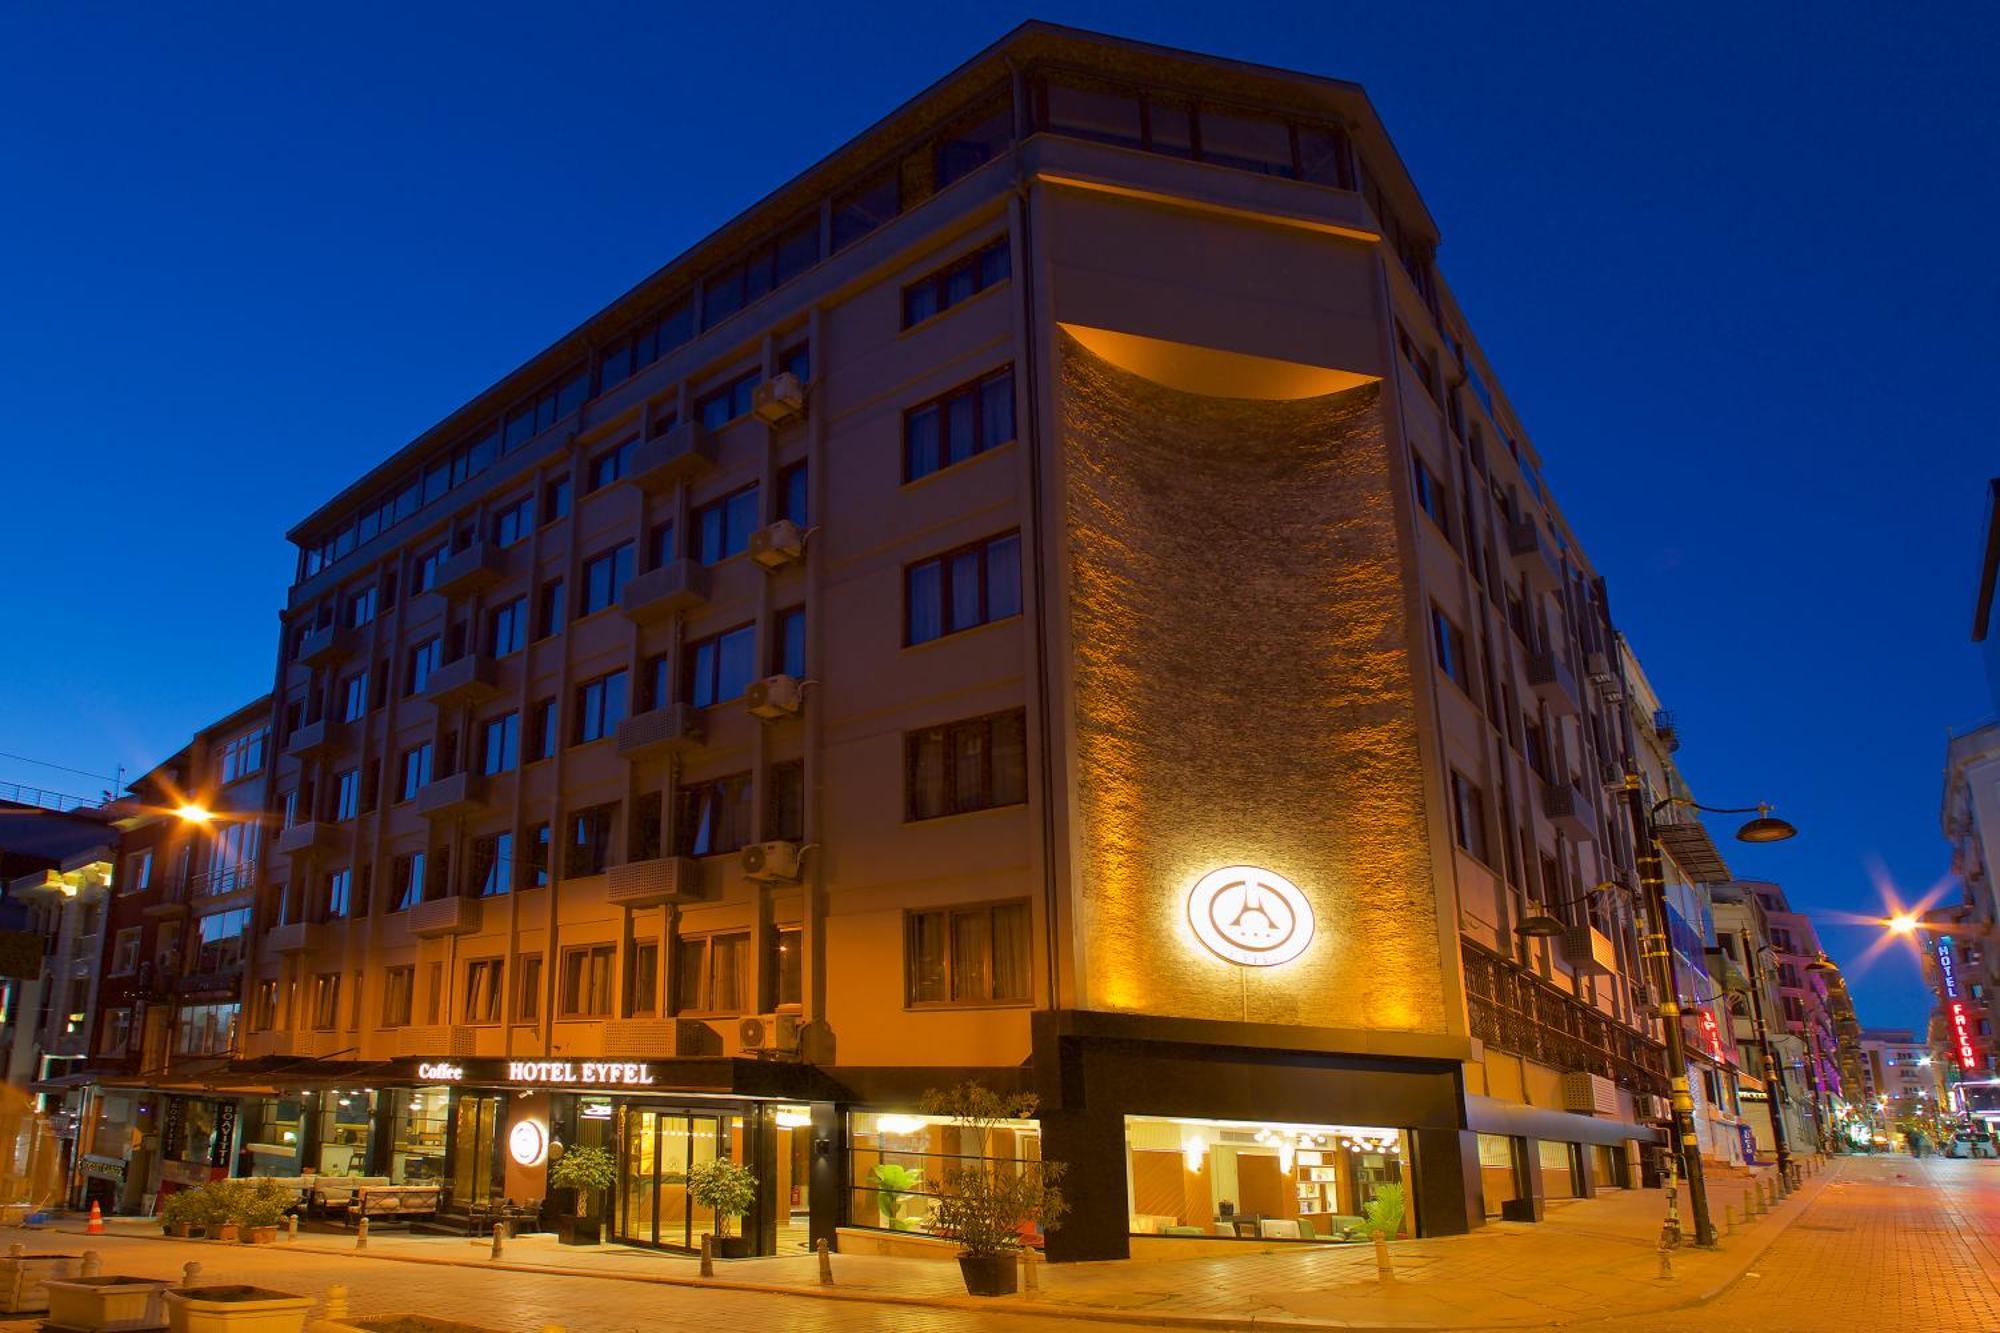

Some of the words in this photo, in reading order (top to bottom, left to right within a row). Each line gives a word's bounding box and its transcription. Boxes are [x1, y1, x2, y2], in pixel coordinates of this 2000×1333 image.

[1937, 945, 1957, 998] HOTEL
[1953, 1004, 1975, 1068] FALCON
[419, 1063, 462, 1080] Coffee
[509, 1062, 577, 1082] HOTEL
[582, 1063, 653, 1084] EYFEL
